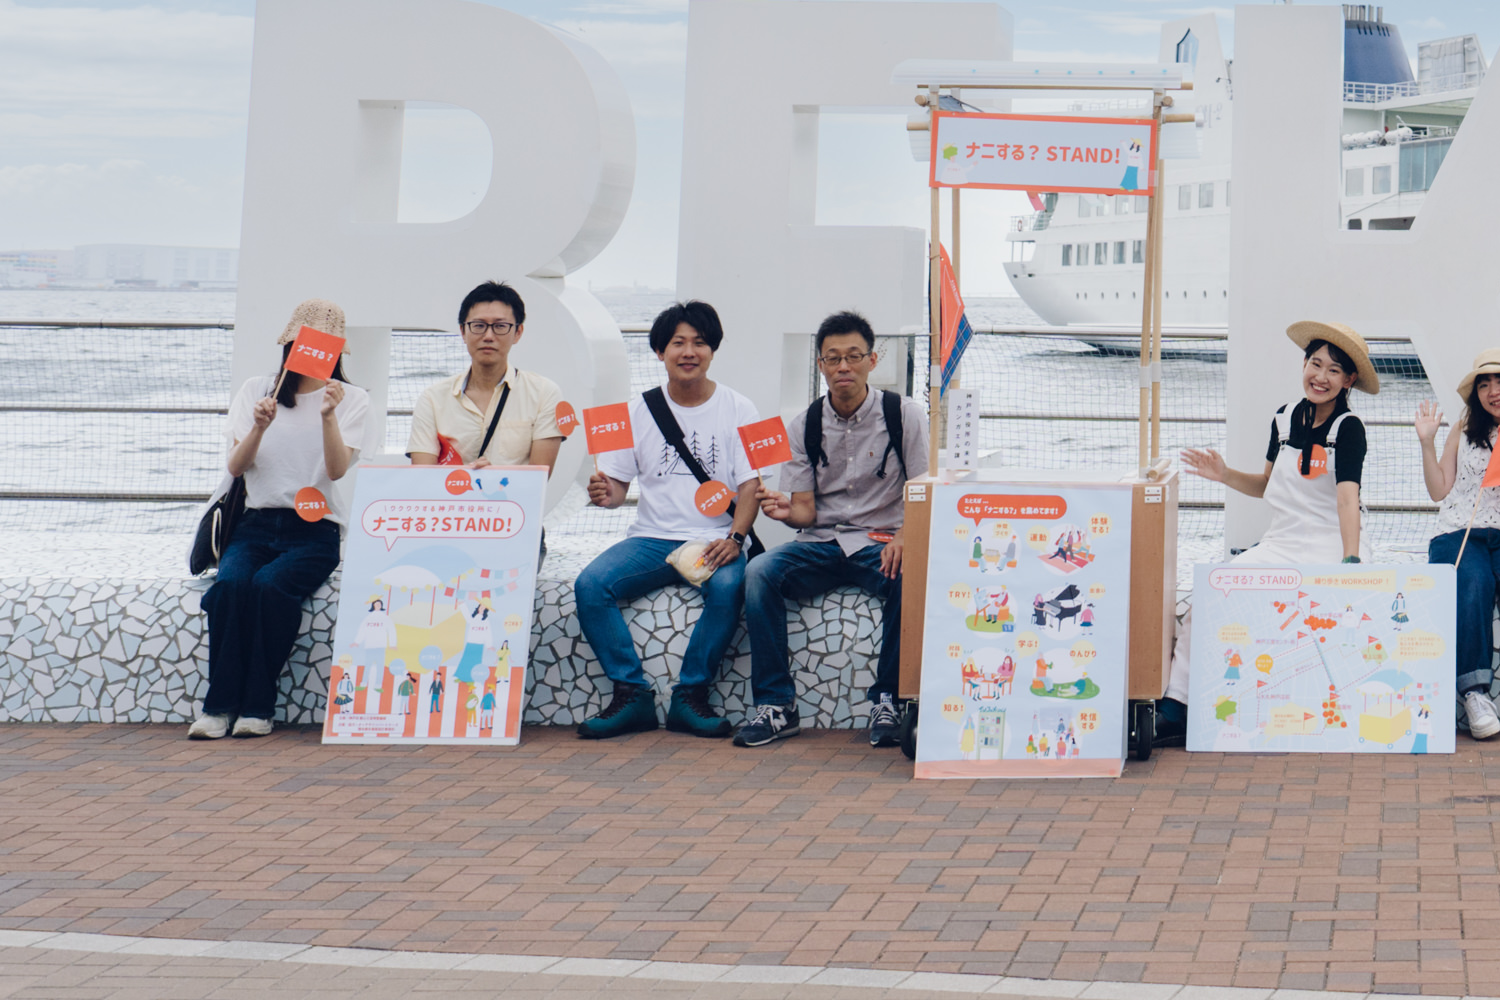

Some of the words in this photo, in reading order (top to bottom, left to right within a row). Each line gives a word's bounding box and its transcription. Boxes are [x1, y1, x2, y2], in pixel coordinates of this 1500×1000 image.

[966, 141, 1039, 161] ナニする？
[1046, 145, 1121, 165] STAND!
[296, 344, 333, 362] ナニする？
[590, 421, 626, 435] ナニする？
[748, 434, 782, 452] ナニする？
[297, 501, 326, 510] ナニする？
[700, 488, 728, 511] ナニする？
[1259, 575, 1298, 585] STAND!
[949, 591, 971, 599] TRY!
